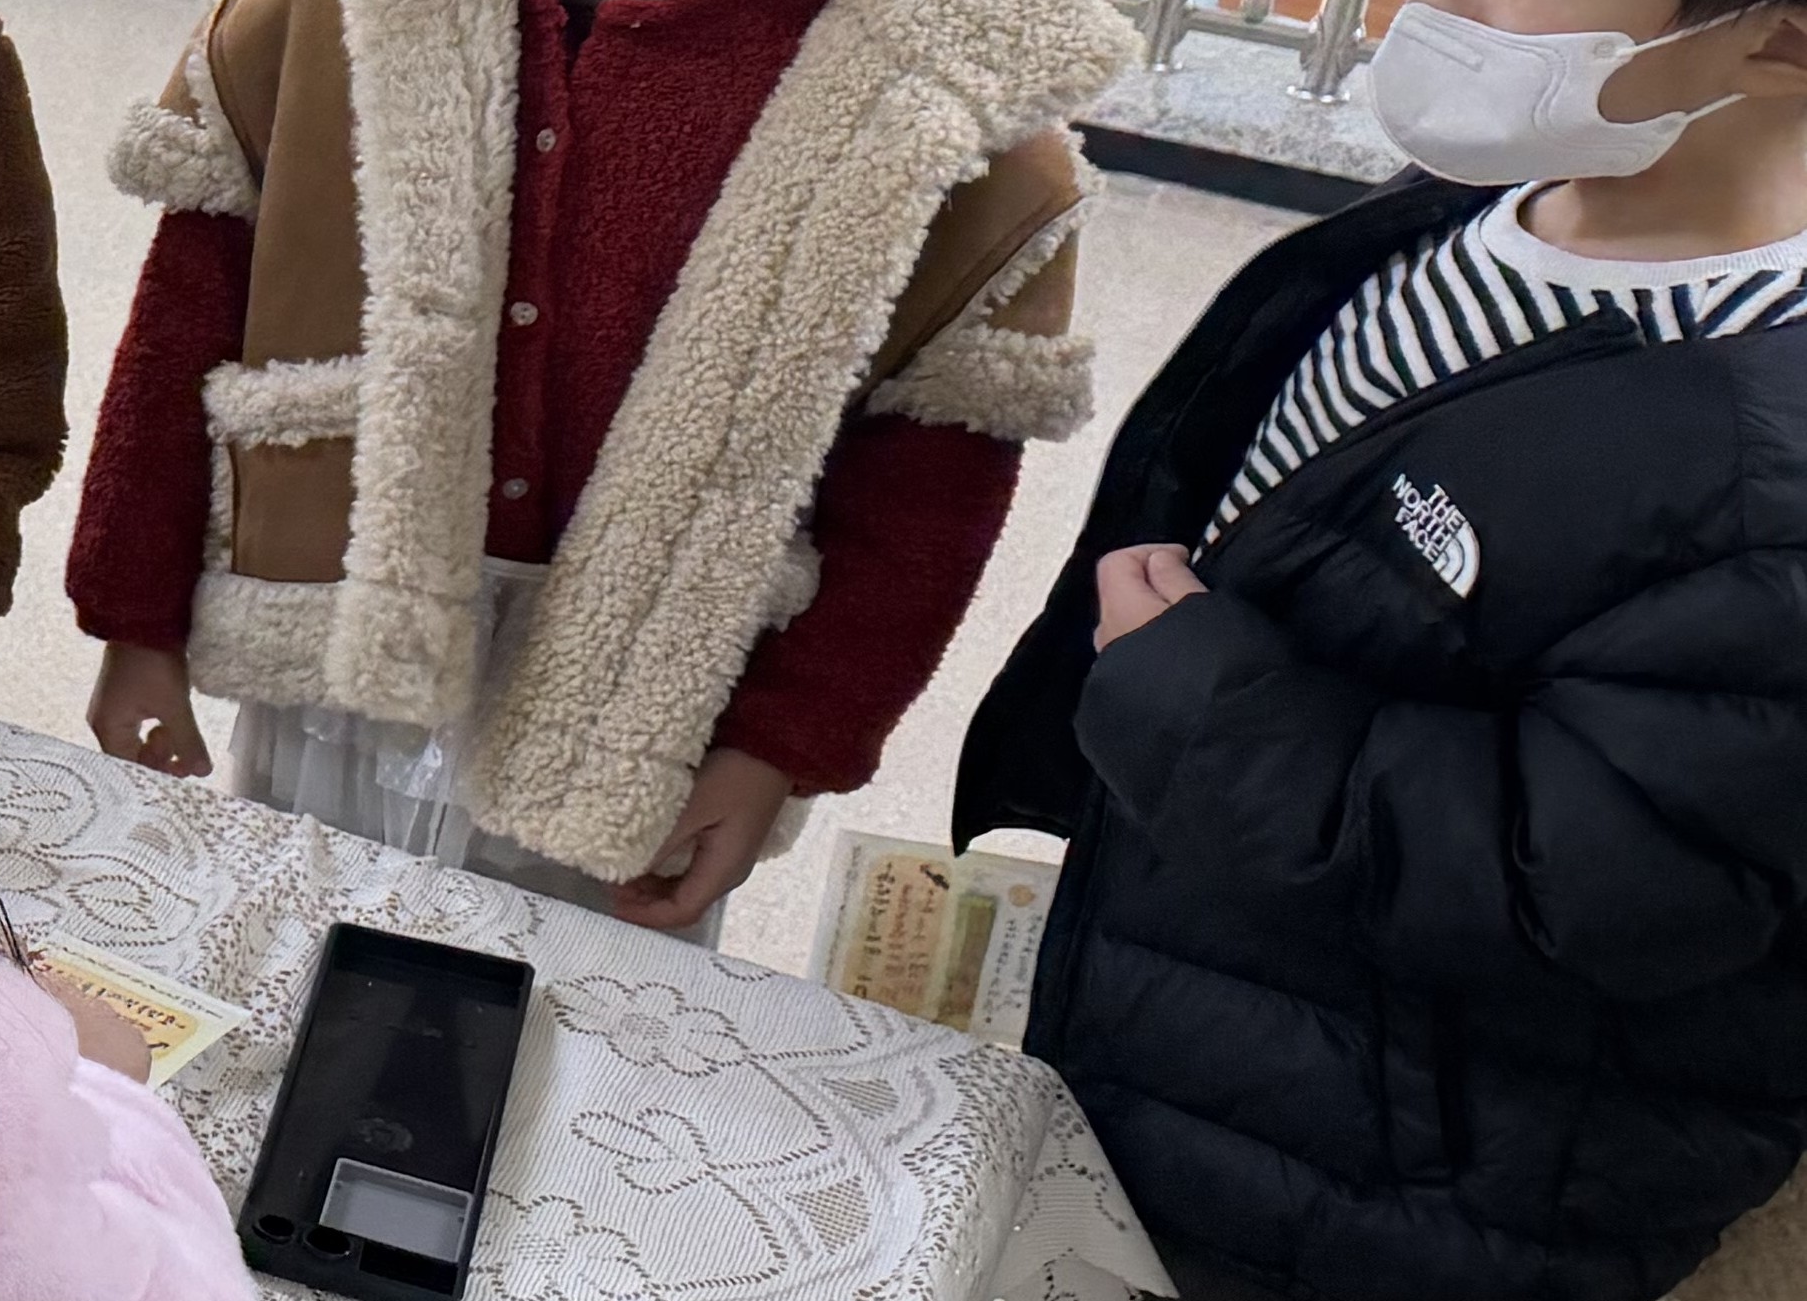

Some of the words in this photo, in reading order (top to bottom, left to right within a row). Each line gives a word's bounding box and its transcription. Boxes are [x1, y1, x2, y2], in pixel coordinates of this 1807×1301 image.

[1392, 473, 1454, 552] NORTH
[1394, 506, 1440, 563] FACE
[1427, 483, 1467, 533] THE
